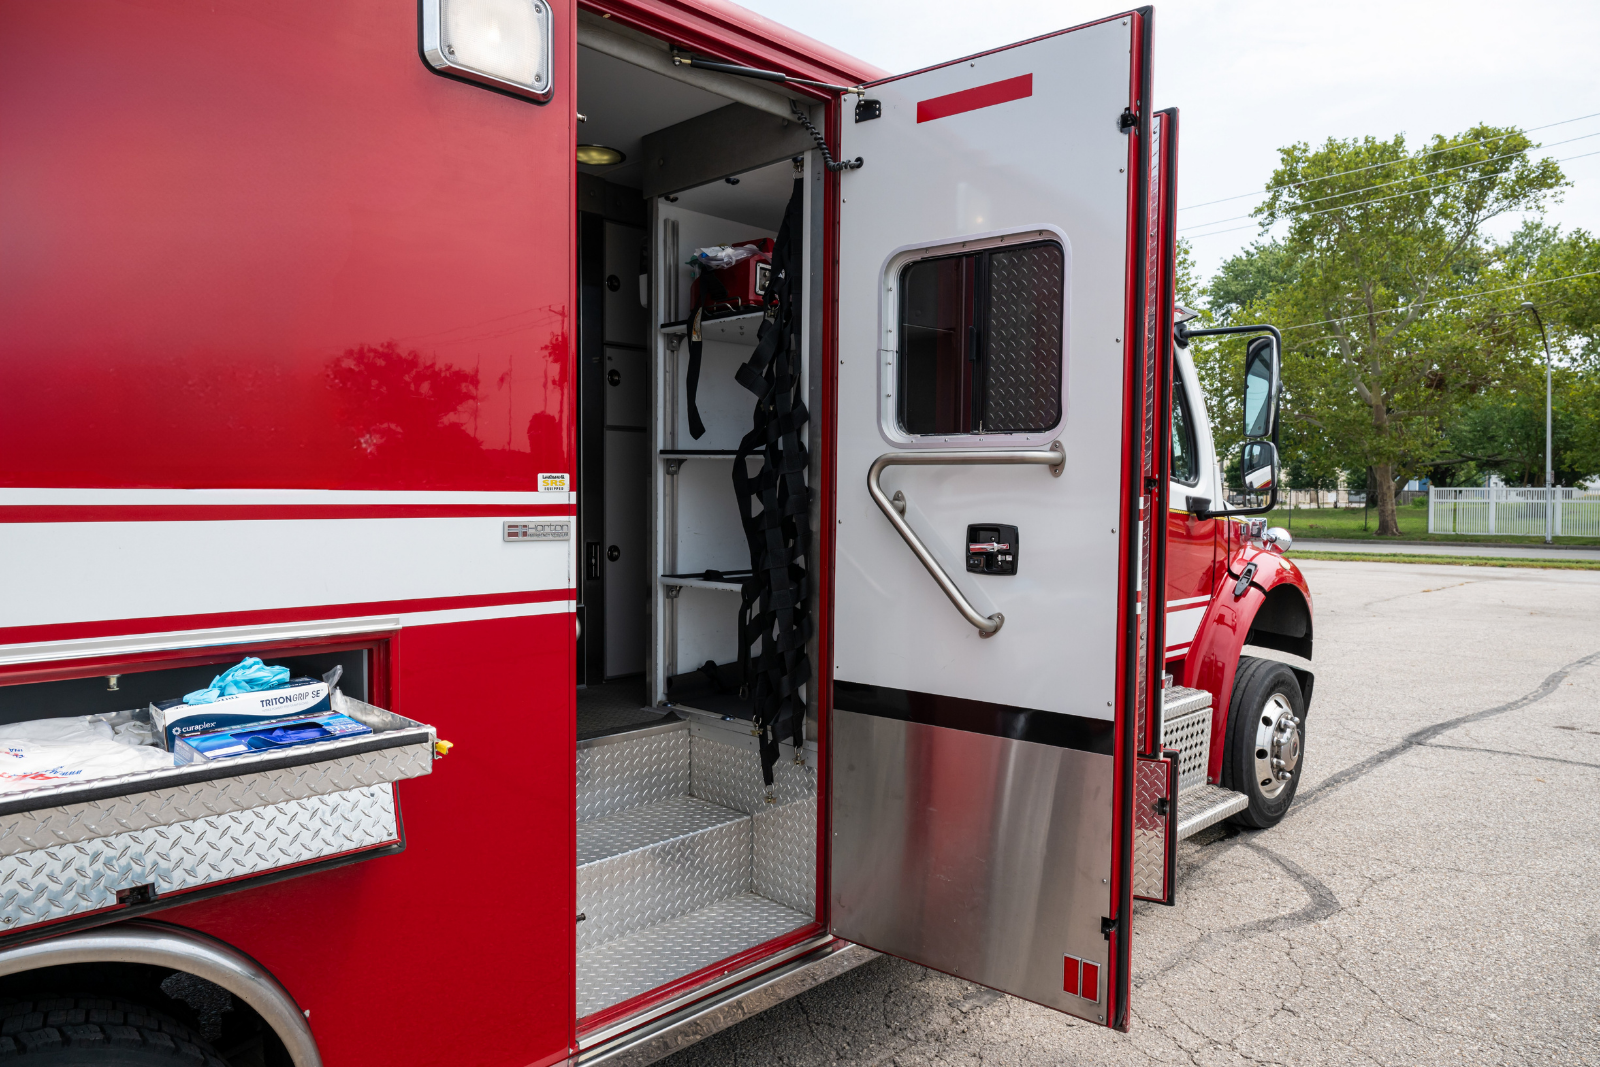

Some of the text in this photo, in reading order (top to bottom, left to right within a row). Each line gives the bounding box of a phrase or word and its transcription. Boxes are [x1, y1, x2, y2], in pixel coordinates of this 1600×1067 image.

[527, 523, 569, 532] Horton
[311, 689, 321, 699] SE
[182, 721, 215, 732] curaplex
